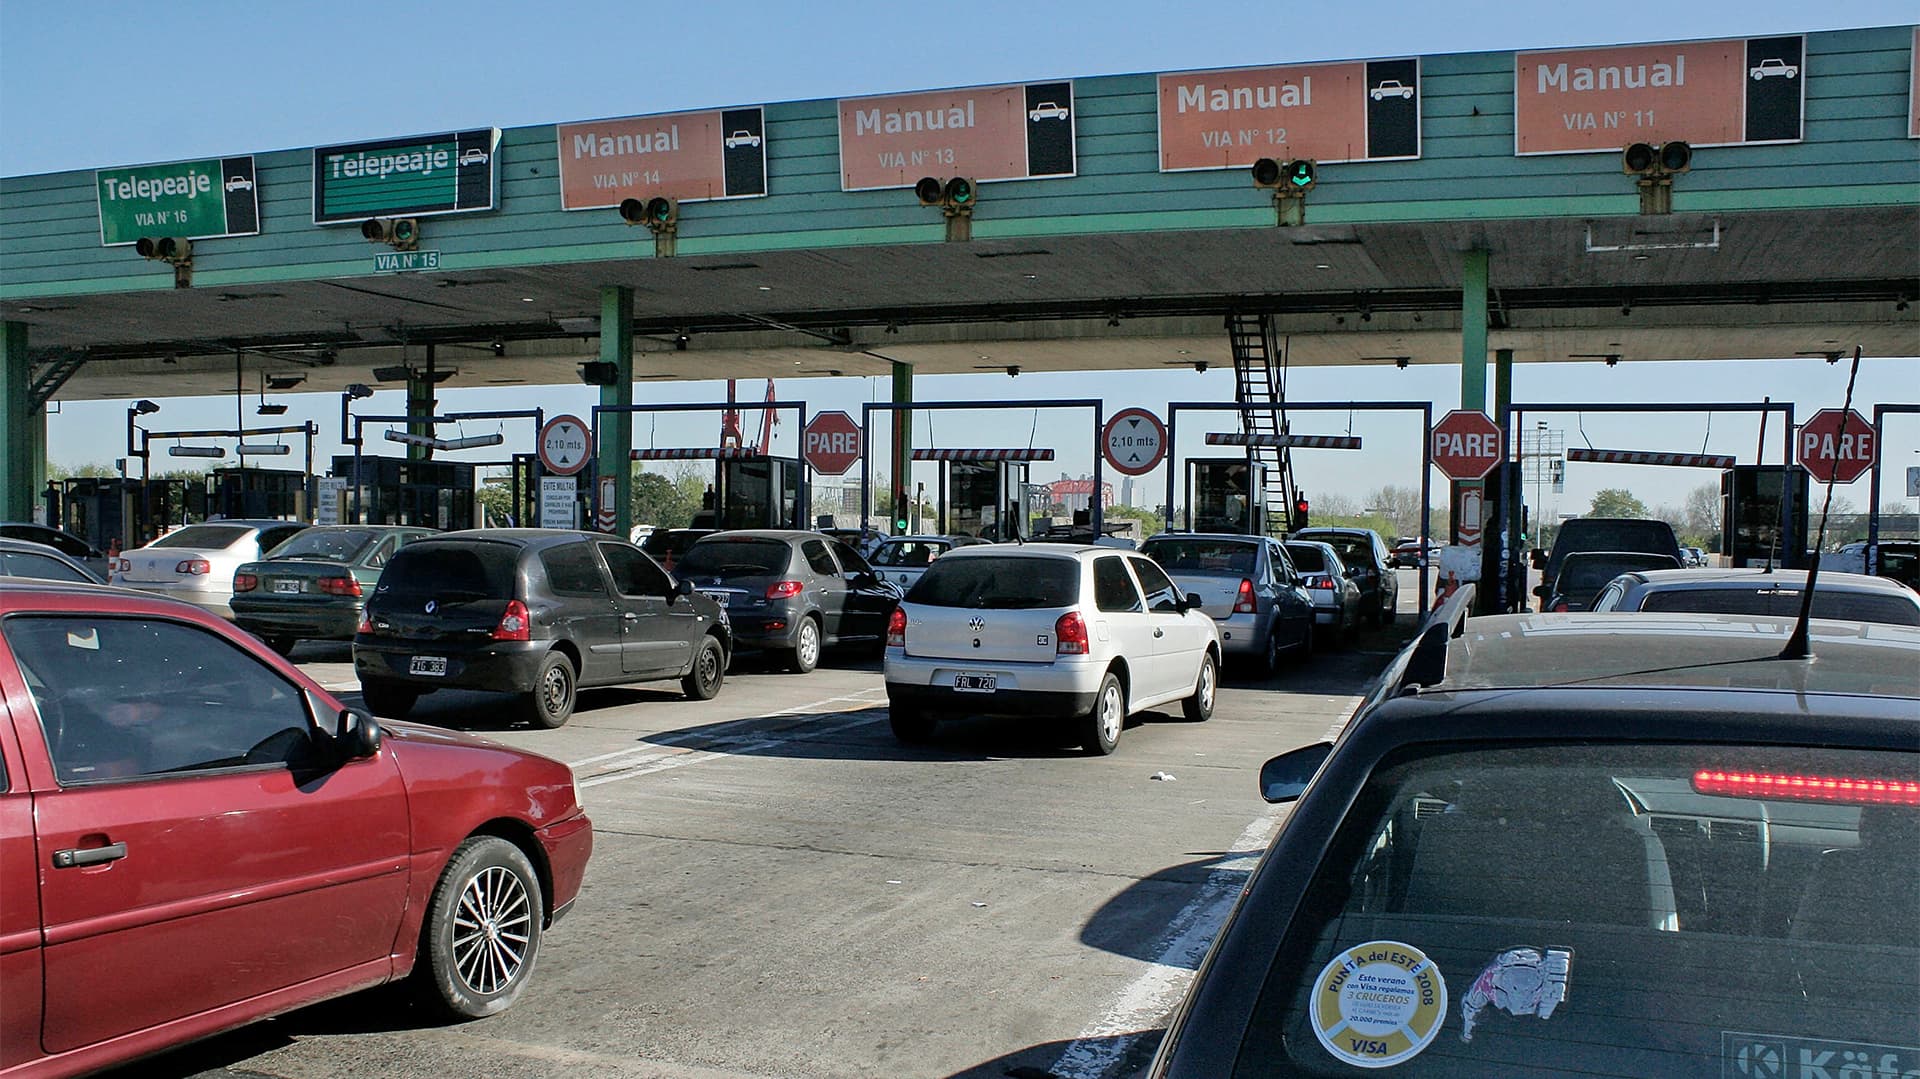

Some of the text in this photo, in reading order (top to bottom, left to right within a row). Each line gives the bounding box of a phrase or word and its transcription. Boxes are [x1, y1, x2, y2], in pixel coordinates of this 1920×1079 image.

[1536, 55, 1685, 94] Manual
[1177, 76, 1312, 113] Manual
[855, 99, 976, 137] Manual
[1563, 112, 1597, 131] VIA
[1634, 110, 1655, 128] 11
[574, 124, 680, 160] Manual
[1201, 130, 1232, 148] VIA
[1266, 128, 1287, 145] 12
[328, 145, 449, 179] Telepeaje
[878, 152, 906, 168] VIA
[935, 149, 954, 164] 13
[104, 170, 211, 202] Telepeaje
[593, 174, 618, 189] VIA
[643, 170, 660, 185] 14
[135, 213, 154, 227] VIA
[174, 210, 188, 223] 16
[377, 255, 399, 269] VIA
[422, 253, 437, 267] 15
[807, 432, 857, 454] PARE
[1136, 436, 1157, 447] mts.
[1435, 433, 1497, 457] PARE
[1803, 432, 1872, 460] PARE
[955, 676, 994, 689] FRL 720
[1328, 951, 1434, 1006] PUNTA del ESTE 2008
[1358, 974, 1407, 985] Este verano
[1347, 992, 1410, 1004] 3 CRUCEROS
[1378, 986, 1415, 995] regalamos
[1350, 1038, 1387, 1055] VISA
